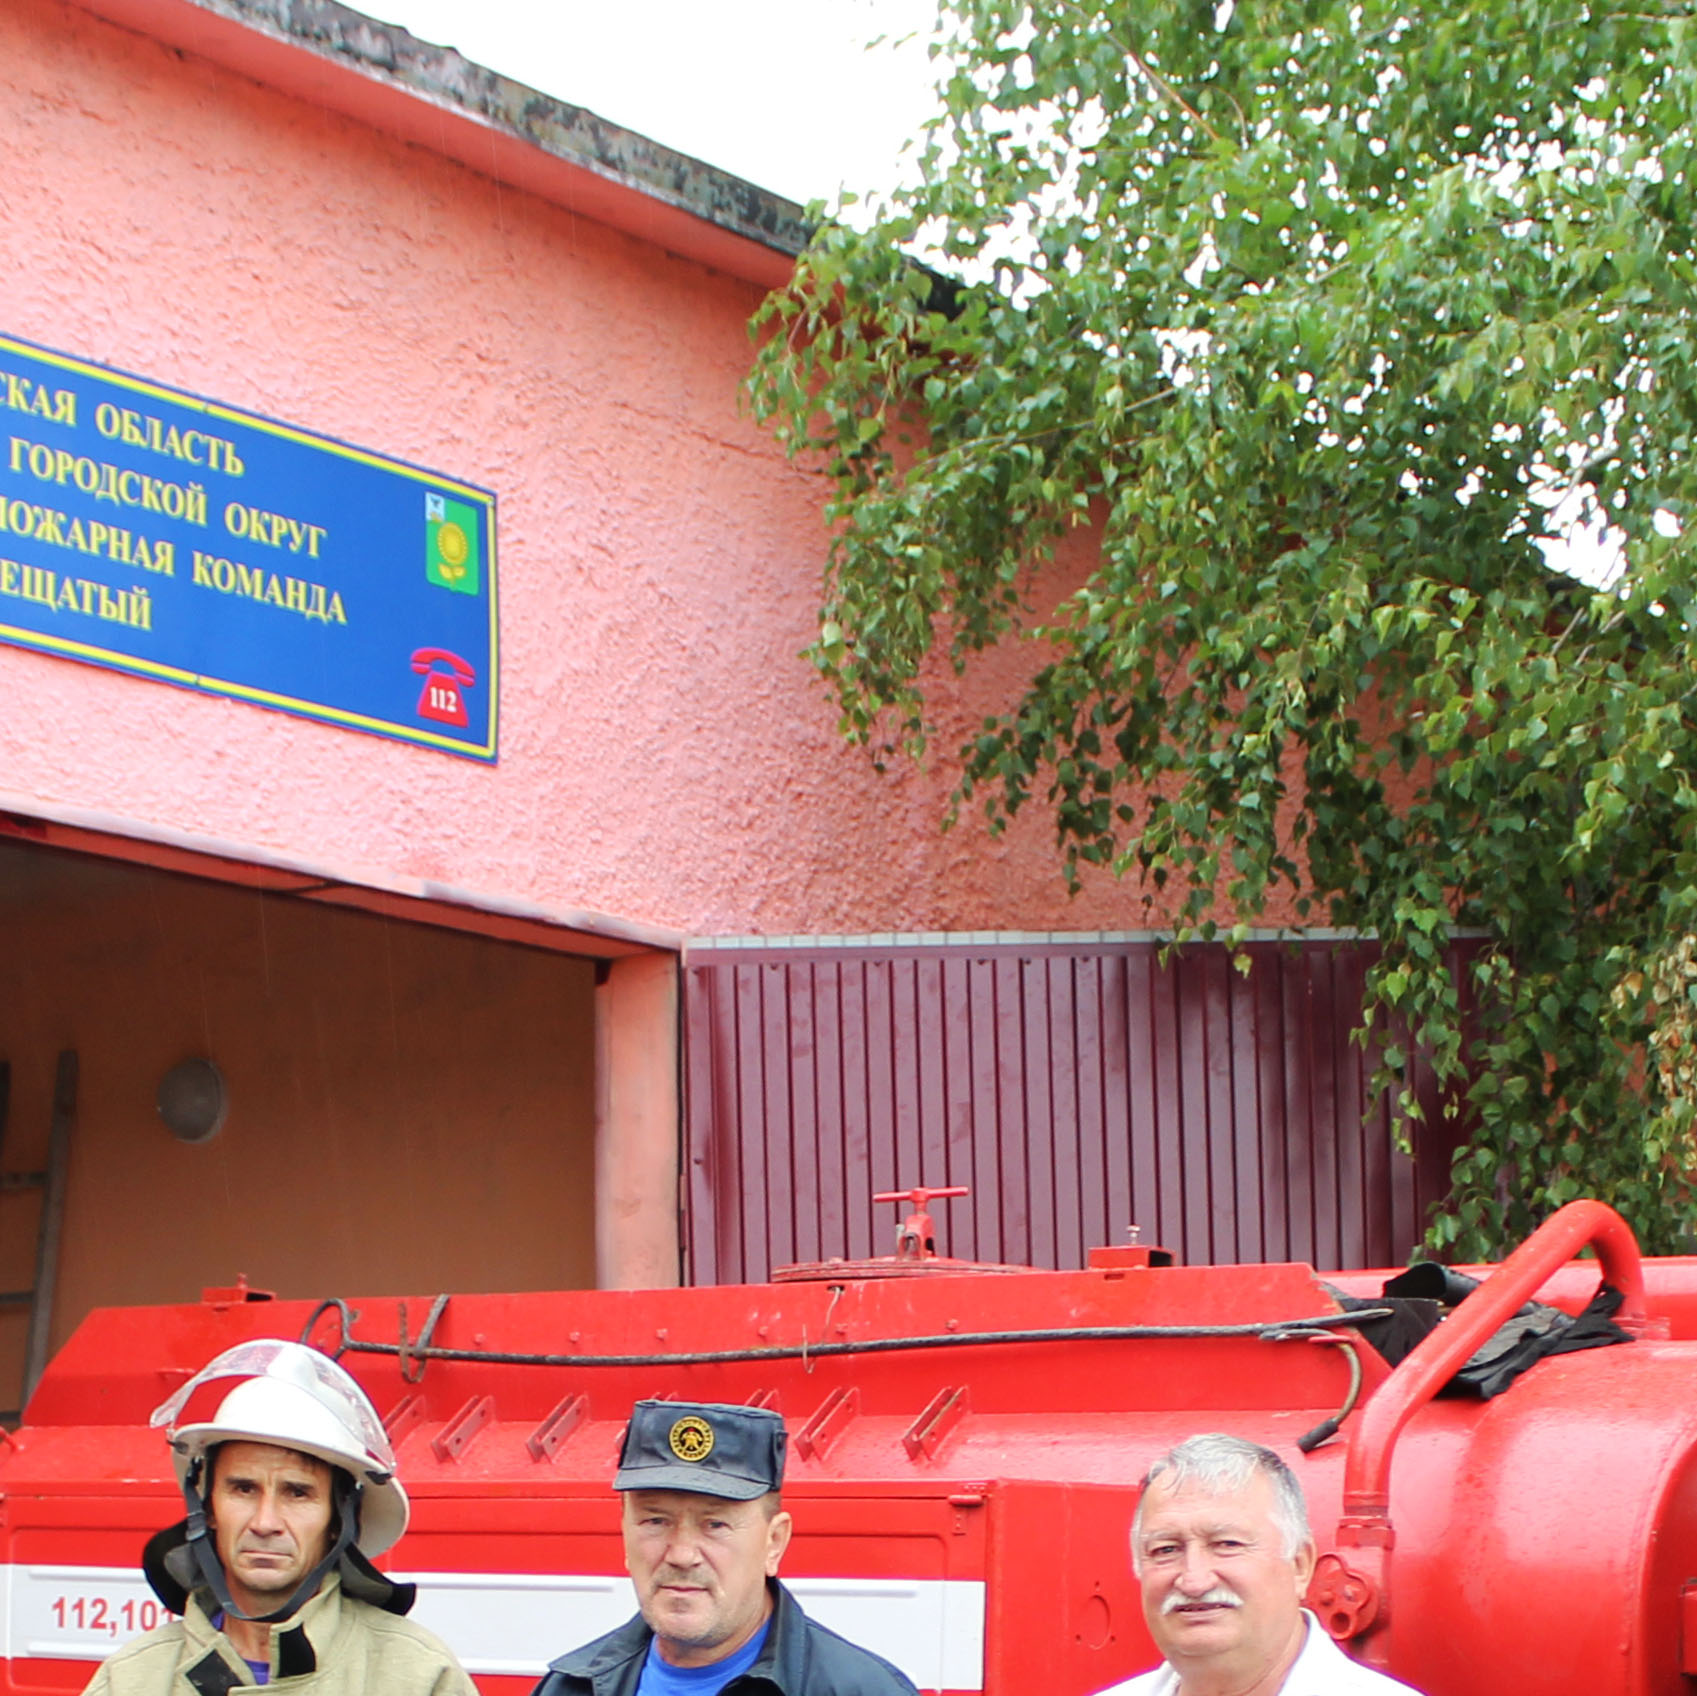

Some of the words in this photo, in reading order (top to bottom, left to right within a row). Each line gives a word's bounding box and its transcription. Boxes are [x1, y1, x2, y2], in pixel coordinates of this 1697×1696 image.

[94, 403, 245, 477] ОБЛАСТЬ
[9, 436, 208, 526] ГОРОДСКОЙ
[224, 502, 327, 558] ОКРУГ
[192, 550, 348, 625] КОМАНДА
[430, 686, 457, 713] 112
